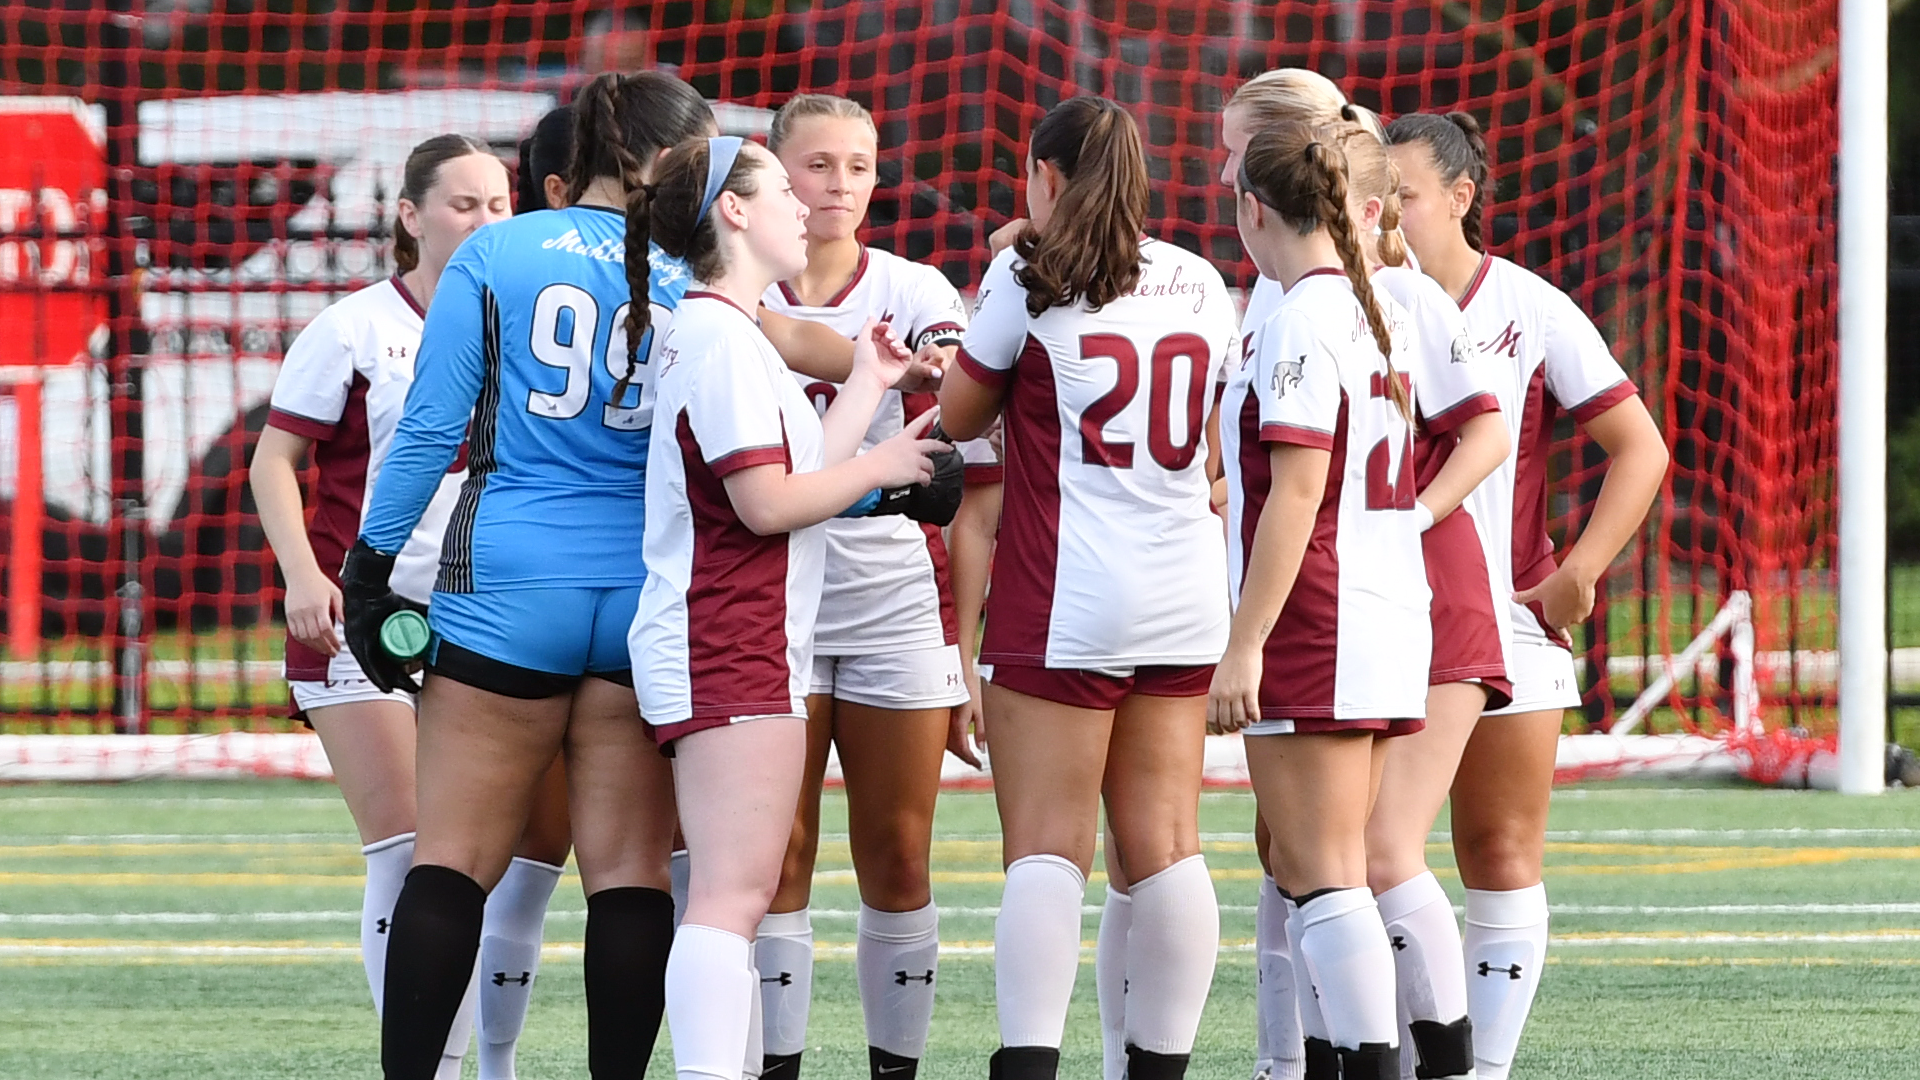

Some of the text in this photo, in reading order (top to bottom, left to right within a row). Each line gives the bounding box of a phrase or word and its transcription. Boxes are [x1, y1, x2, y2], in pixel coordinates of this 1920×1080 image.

[526, 282, 673, 432] 99
[1122, 264, 1209, 314] lenberg
[1078, 332, 1211, 471] 20
